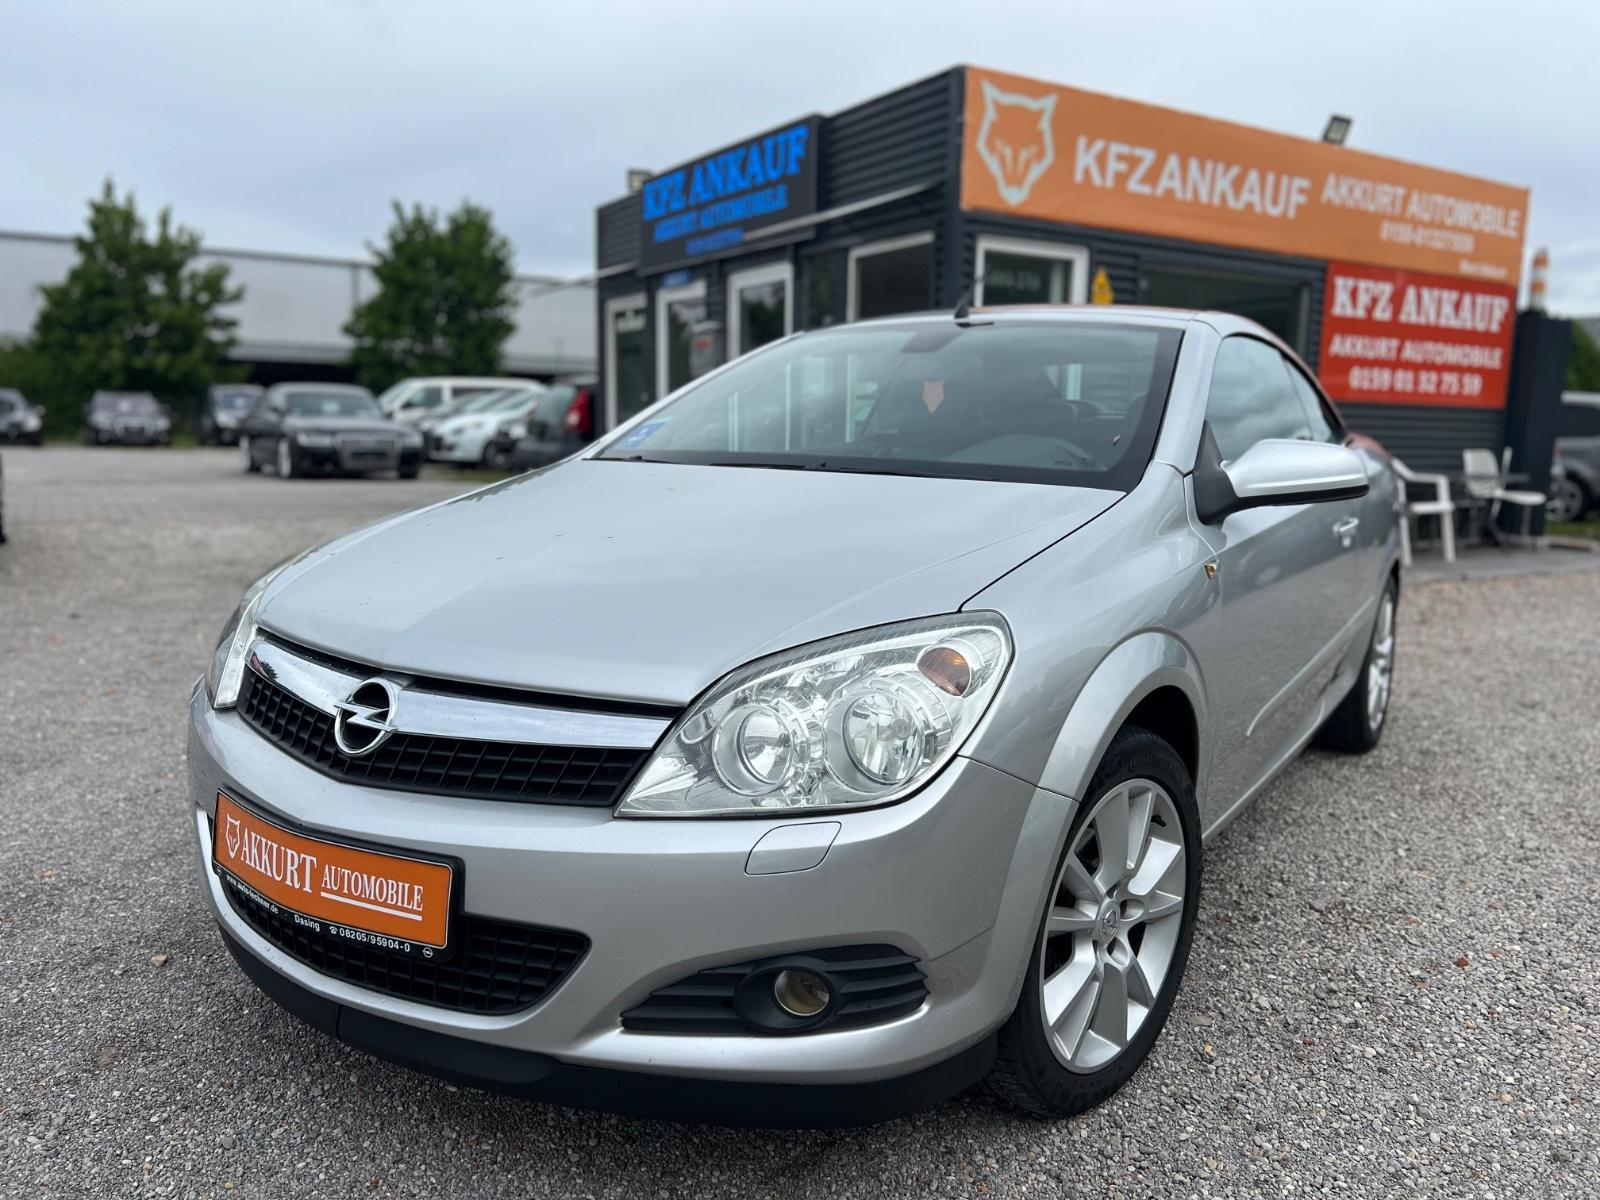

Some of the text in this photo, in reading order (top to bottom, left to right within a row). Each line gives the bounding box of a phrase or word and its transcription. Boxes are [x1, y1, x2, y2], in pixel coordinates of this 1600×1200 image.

[642, 124, 809, 221] KFZ ANKAUF
[1321, 173, 1520, 237] AKKURT AUTOMOBILE
[1331, 275, 1510, 333] KFZ ANKAUF
[1329, 333, 1504, 369] AKKURT AUTOMOBILE
[241, 829, 424, 912] AKKURT AUTOMOBILE
[294, 914, 320, 932] Dasing
[339, 927, 411, 953] 08205/95904-0
